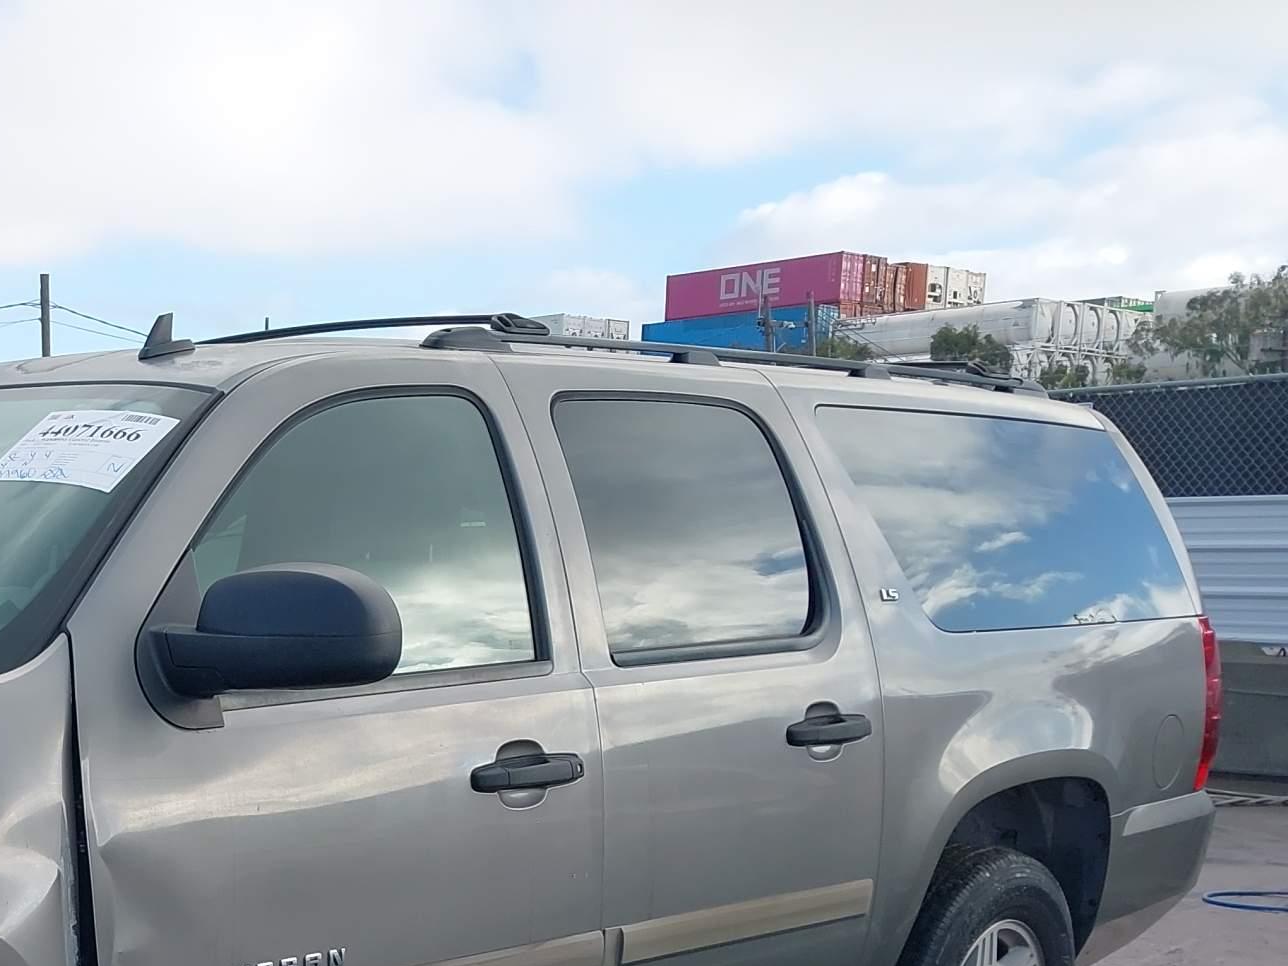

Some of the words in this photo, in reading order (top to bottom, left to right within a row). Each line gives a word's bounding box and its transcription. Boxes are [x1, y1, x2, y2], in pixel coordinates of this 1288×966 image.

[719, 267, 781, 300] ONE
[39, 423, 147, 442] 44071666
[880, 588, 899, 602] LS
